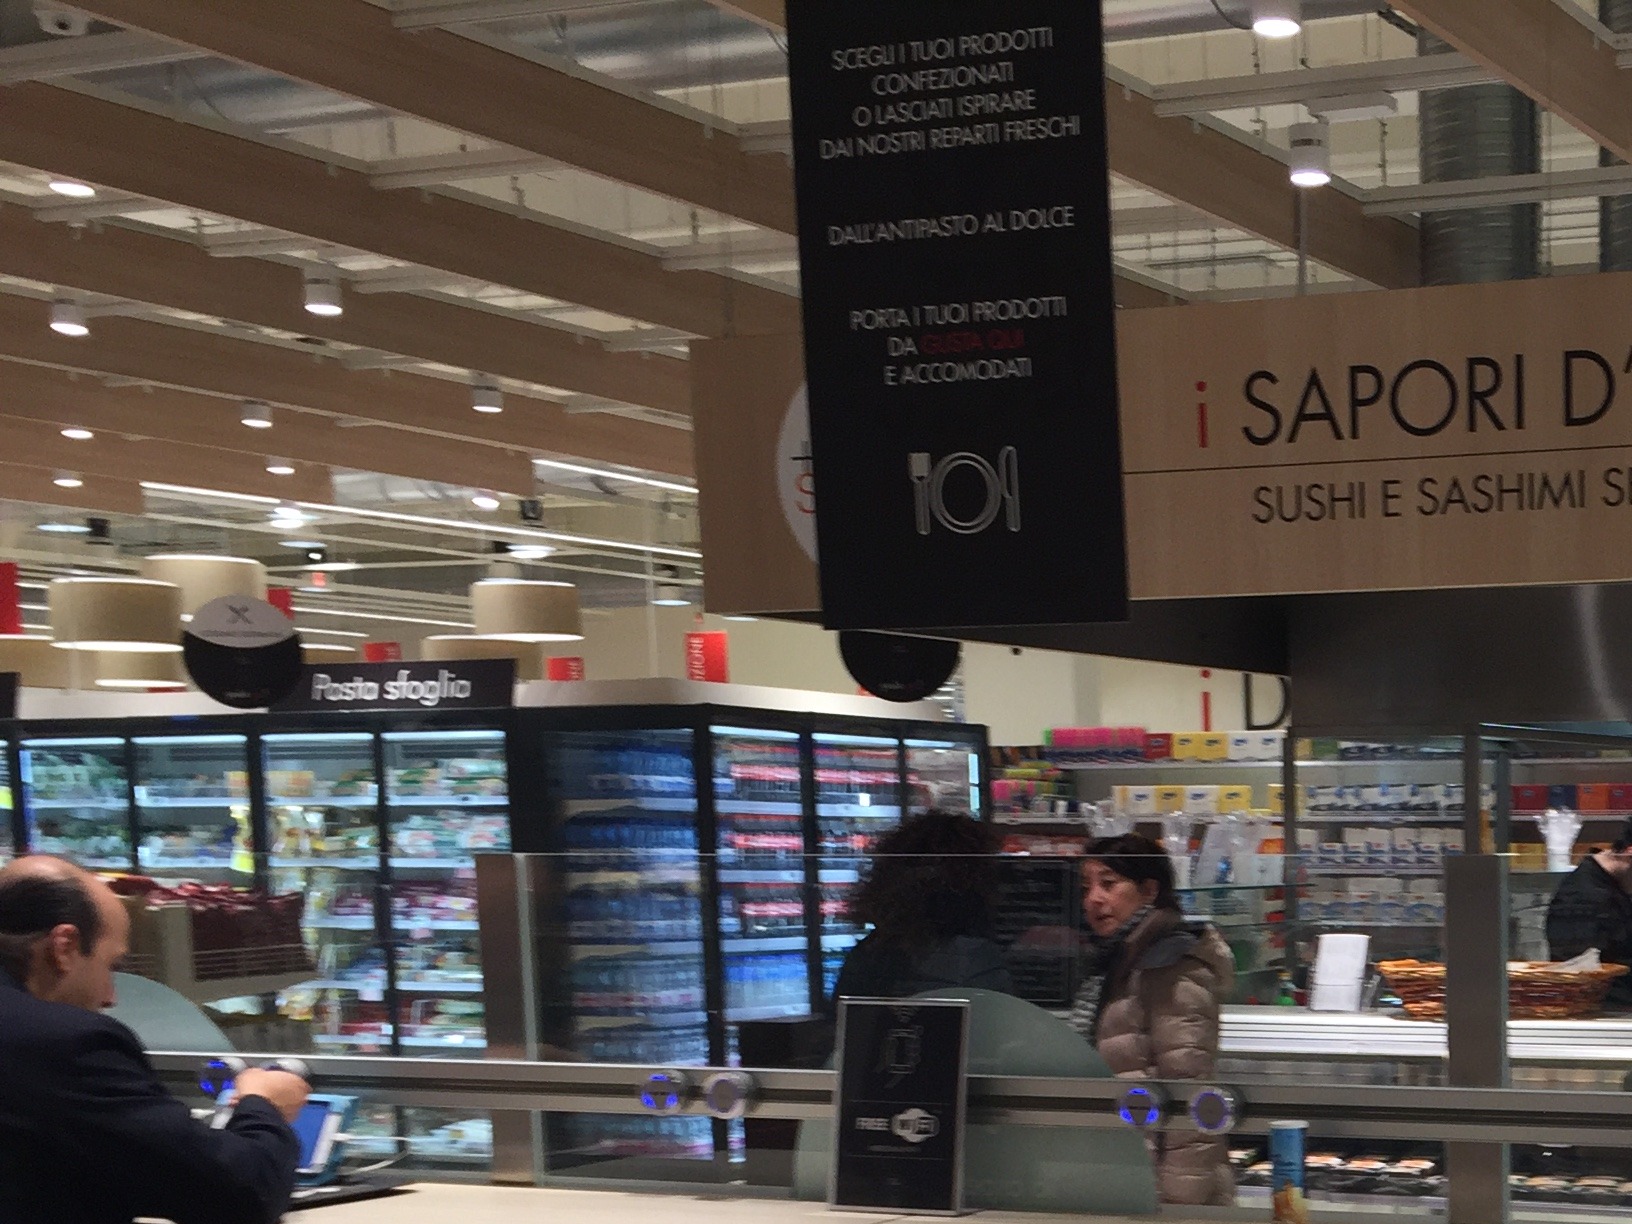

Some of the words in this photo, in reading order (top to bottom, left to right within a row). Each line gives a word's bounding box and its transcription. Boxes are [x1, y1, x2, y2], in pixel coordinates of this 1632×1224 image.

[832, 45, 895, 71] SCEGLI
[899, 43, 906, 63] I
[908, 38, 955, 62] TUOI
[959, 27, 1053, 53] PRODOTTI
[871, 61, 1014, 96] CONFEZIONATI
[852, 105, 872, 127] O
[875, 98, 952, 125] LASCIATI
[957, 89, 1036, 116] ISPIRARE
[819, 137, 854, 160] DAI
[857, 130, 925, 156] NOSTRI
[929, 123, 1000, 149] REPARTI
[1004, 115, 1081, 142] FRESCHI
[828, 214, 978, 246] DALL'ANTIPASTO
[982, 211, 1007, 233] AL
[1010, 205, 1075, 230] DOLCE
[850, 307, 911, 331] PORTA
[923, 302, 969, 325] TUOI
[972, 296, 1067, 323] PRODOTTI
[887, 336, 919, 357] DA
[883, 365, 898, 386] E
[902, 358, 1032, 385] ACCOMODATI
[1241, 354, 1526, 447] SAPORI
[1252, 480, 1366, 525] SUSHI
[1381, 479, 1402, 517] E
[1416, 470, 1586, 517] SASHIMI
[311, 673, 379, 701] Pasta
